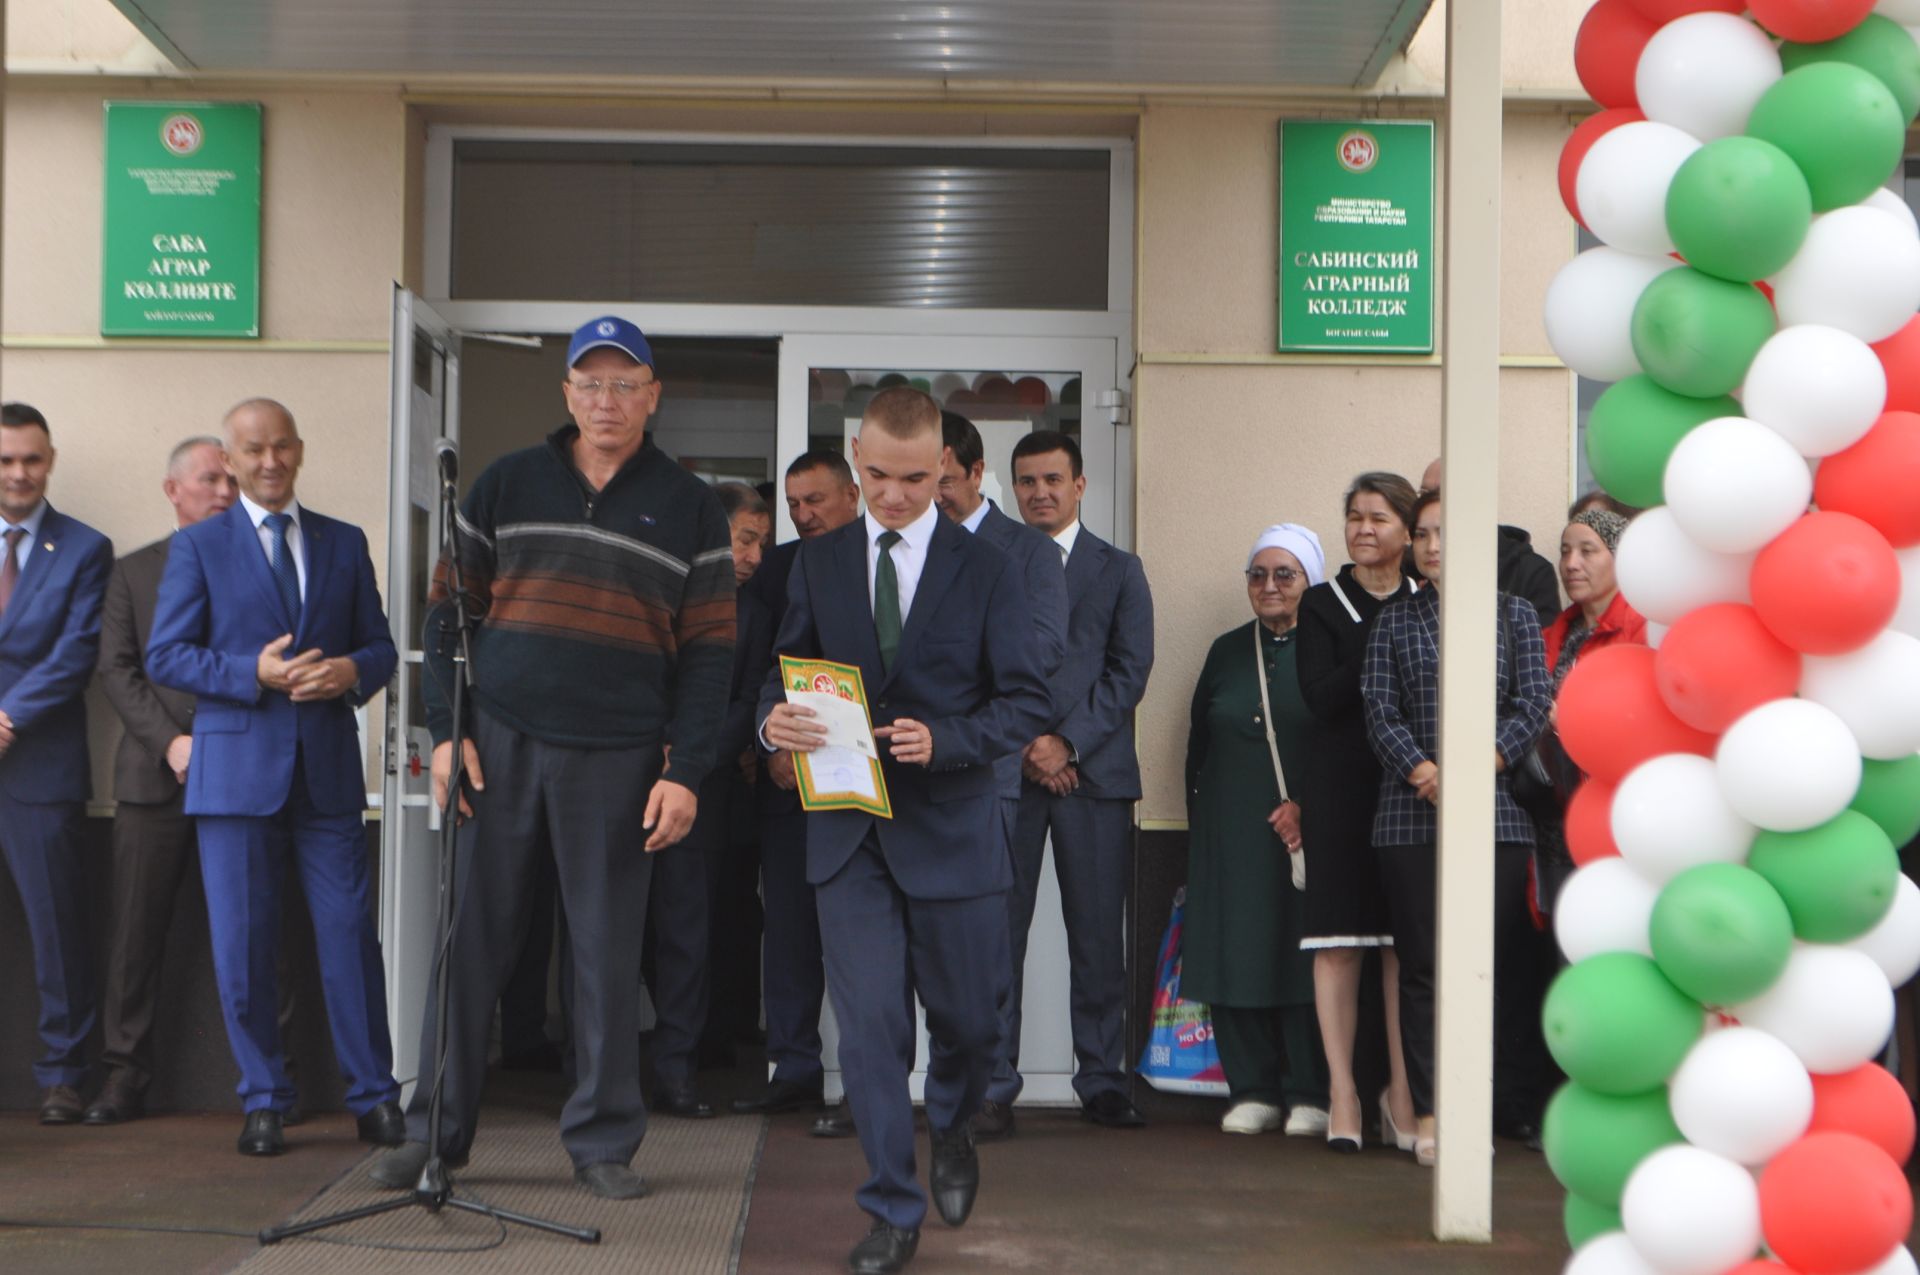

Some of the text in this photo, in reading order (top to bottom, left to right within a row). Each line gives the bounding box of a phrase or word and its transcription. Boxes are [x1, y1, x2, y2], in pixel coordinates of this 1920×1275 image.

[152, 233, 208, 254] САБА
[147, 256, 212, 277] АГРАР
[1294, 248, 1419, 269] САБИНСКИЙ
[1303, 272, 1410, 293] АГРАРНЫЙ
[1307, 298, 1408, 318] КОЛЛЕДЖ
